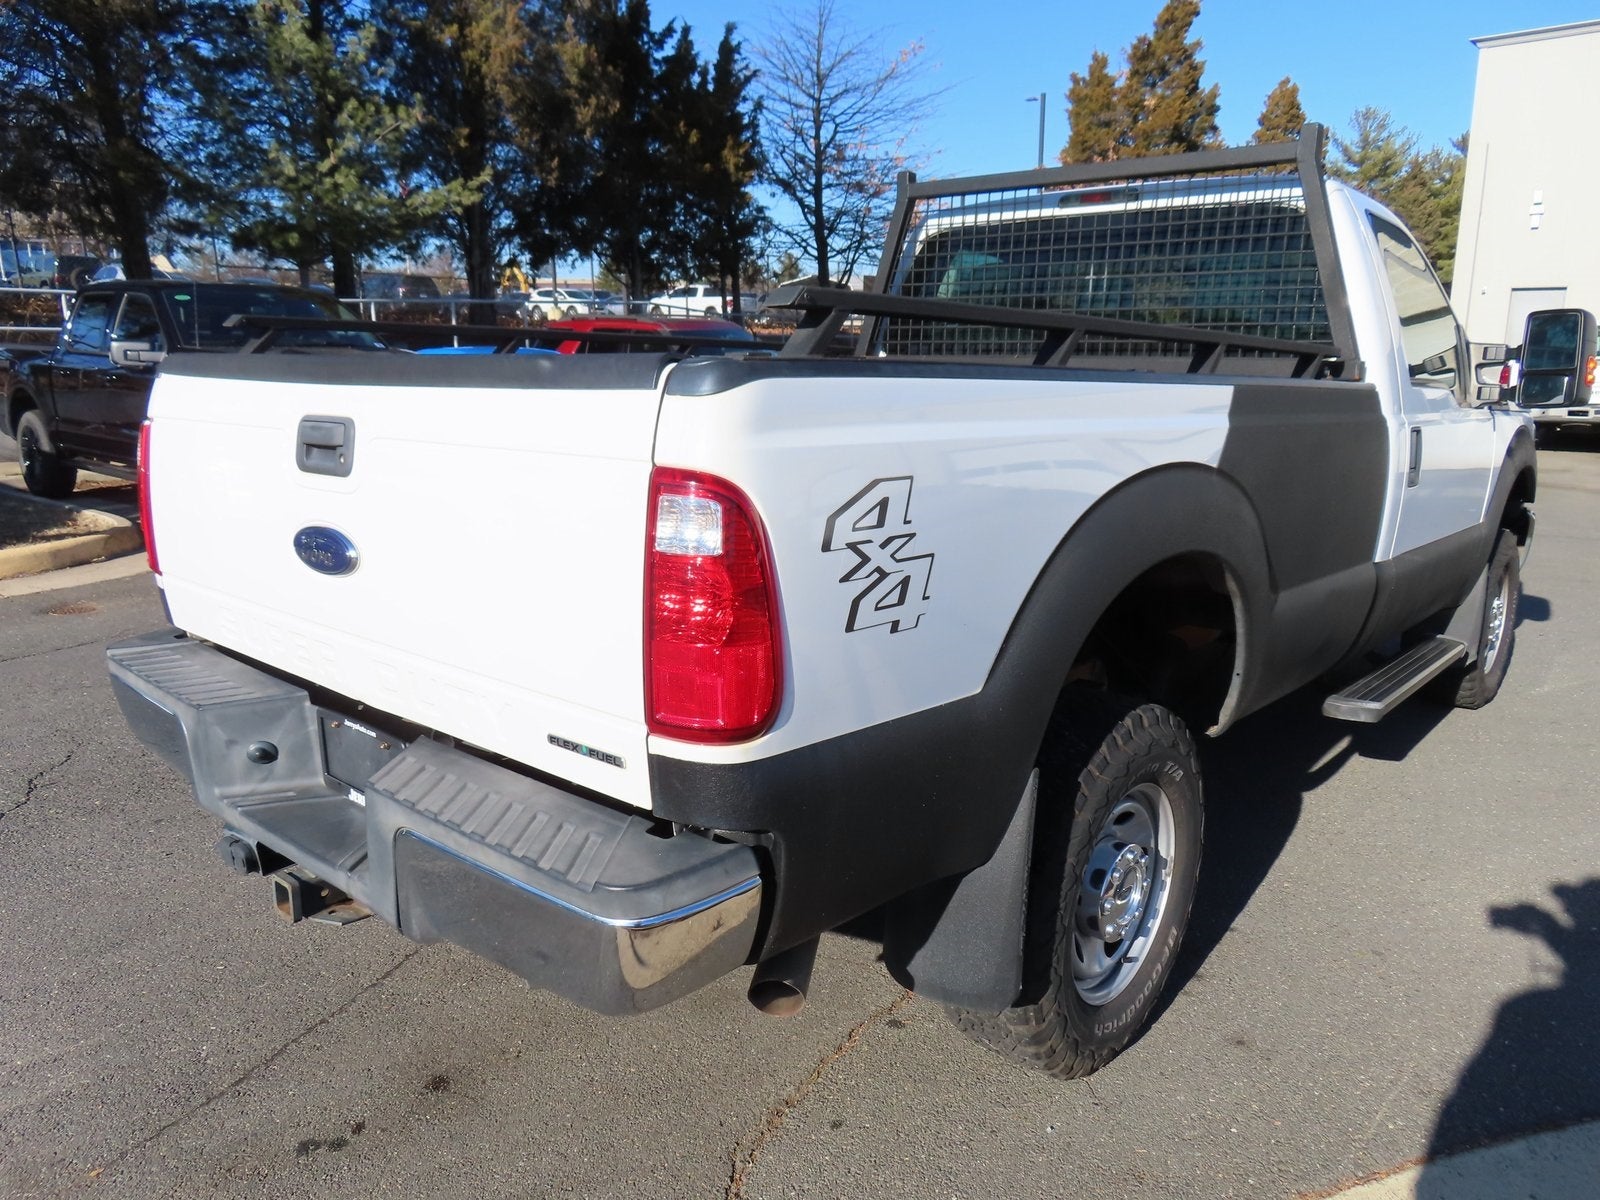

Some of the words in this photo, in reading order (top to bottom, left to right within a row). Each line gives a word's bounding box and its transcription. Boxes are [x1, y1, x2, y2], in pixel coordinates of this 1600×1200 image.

[549, 735, 579, 753] FLEX
[588, 749, 621, 768] FUEL
[1164, 761, 1185, 782] T/A
